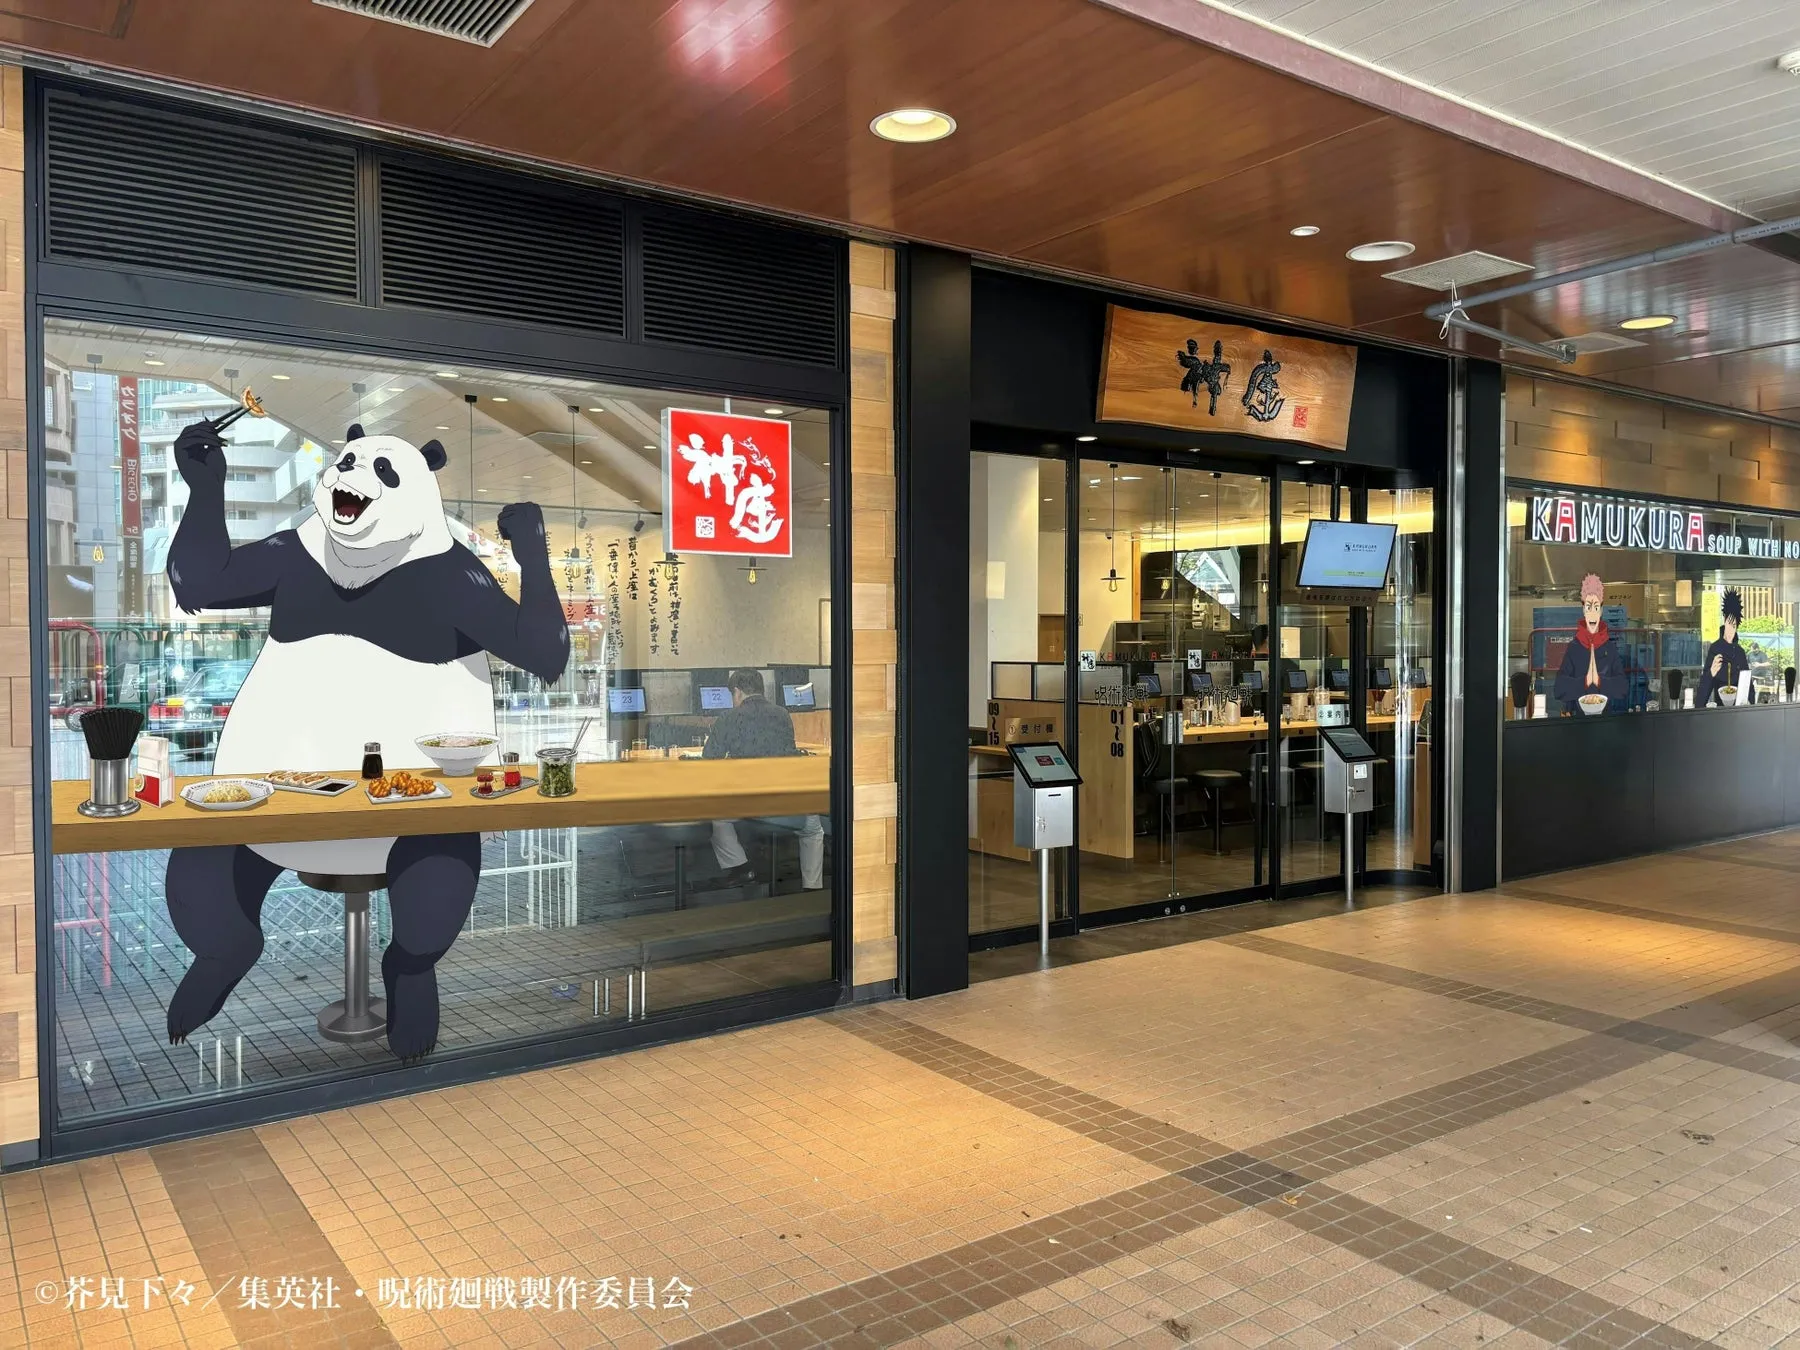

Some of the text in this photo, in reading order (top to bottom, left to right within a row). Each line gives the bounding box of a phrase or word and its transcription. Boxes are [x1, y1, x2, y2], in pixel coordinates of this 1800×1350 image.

[1175, 338, 1286, 422] 神座
[677, 433, 784, 543] 神座
[1531, 496, 1704, 551] KAMUKURA
[1707, 533, 1742, 554] SOUP
[1748, 537, 1781, 558] WITH
[622, 695, 633, 704] 23
[989, 702, 999, 716] 09
[1110, 709, 1124, 725] 01
[989, 731, 1000, 745] 15
[1110, 742, 1124, 757] 08
